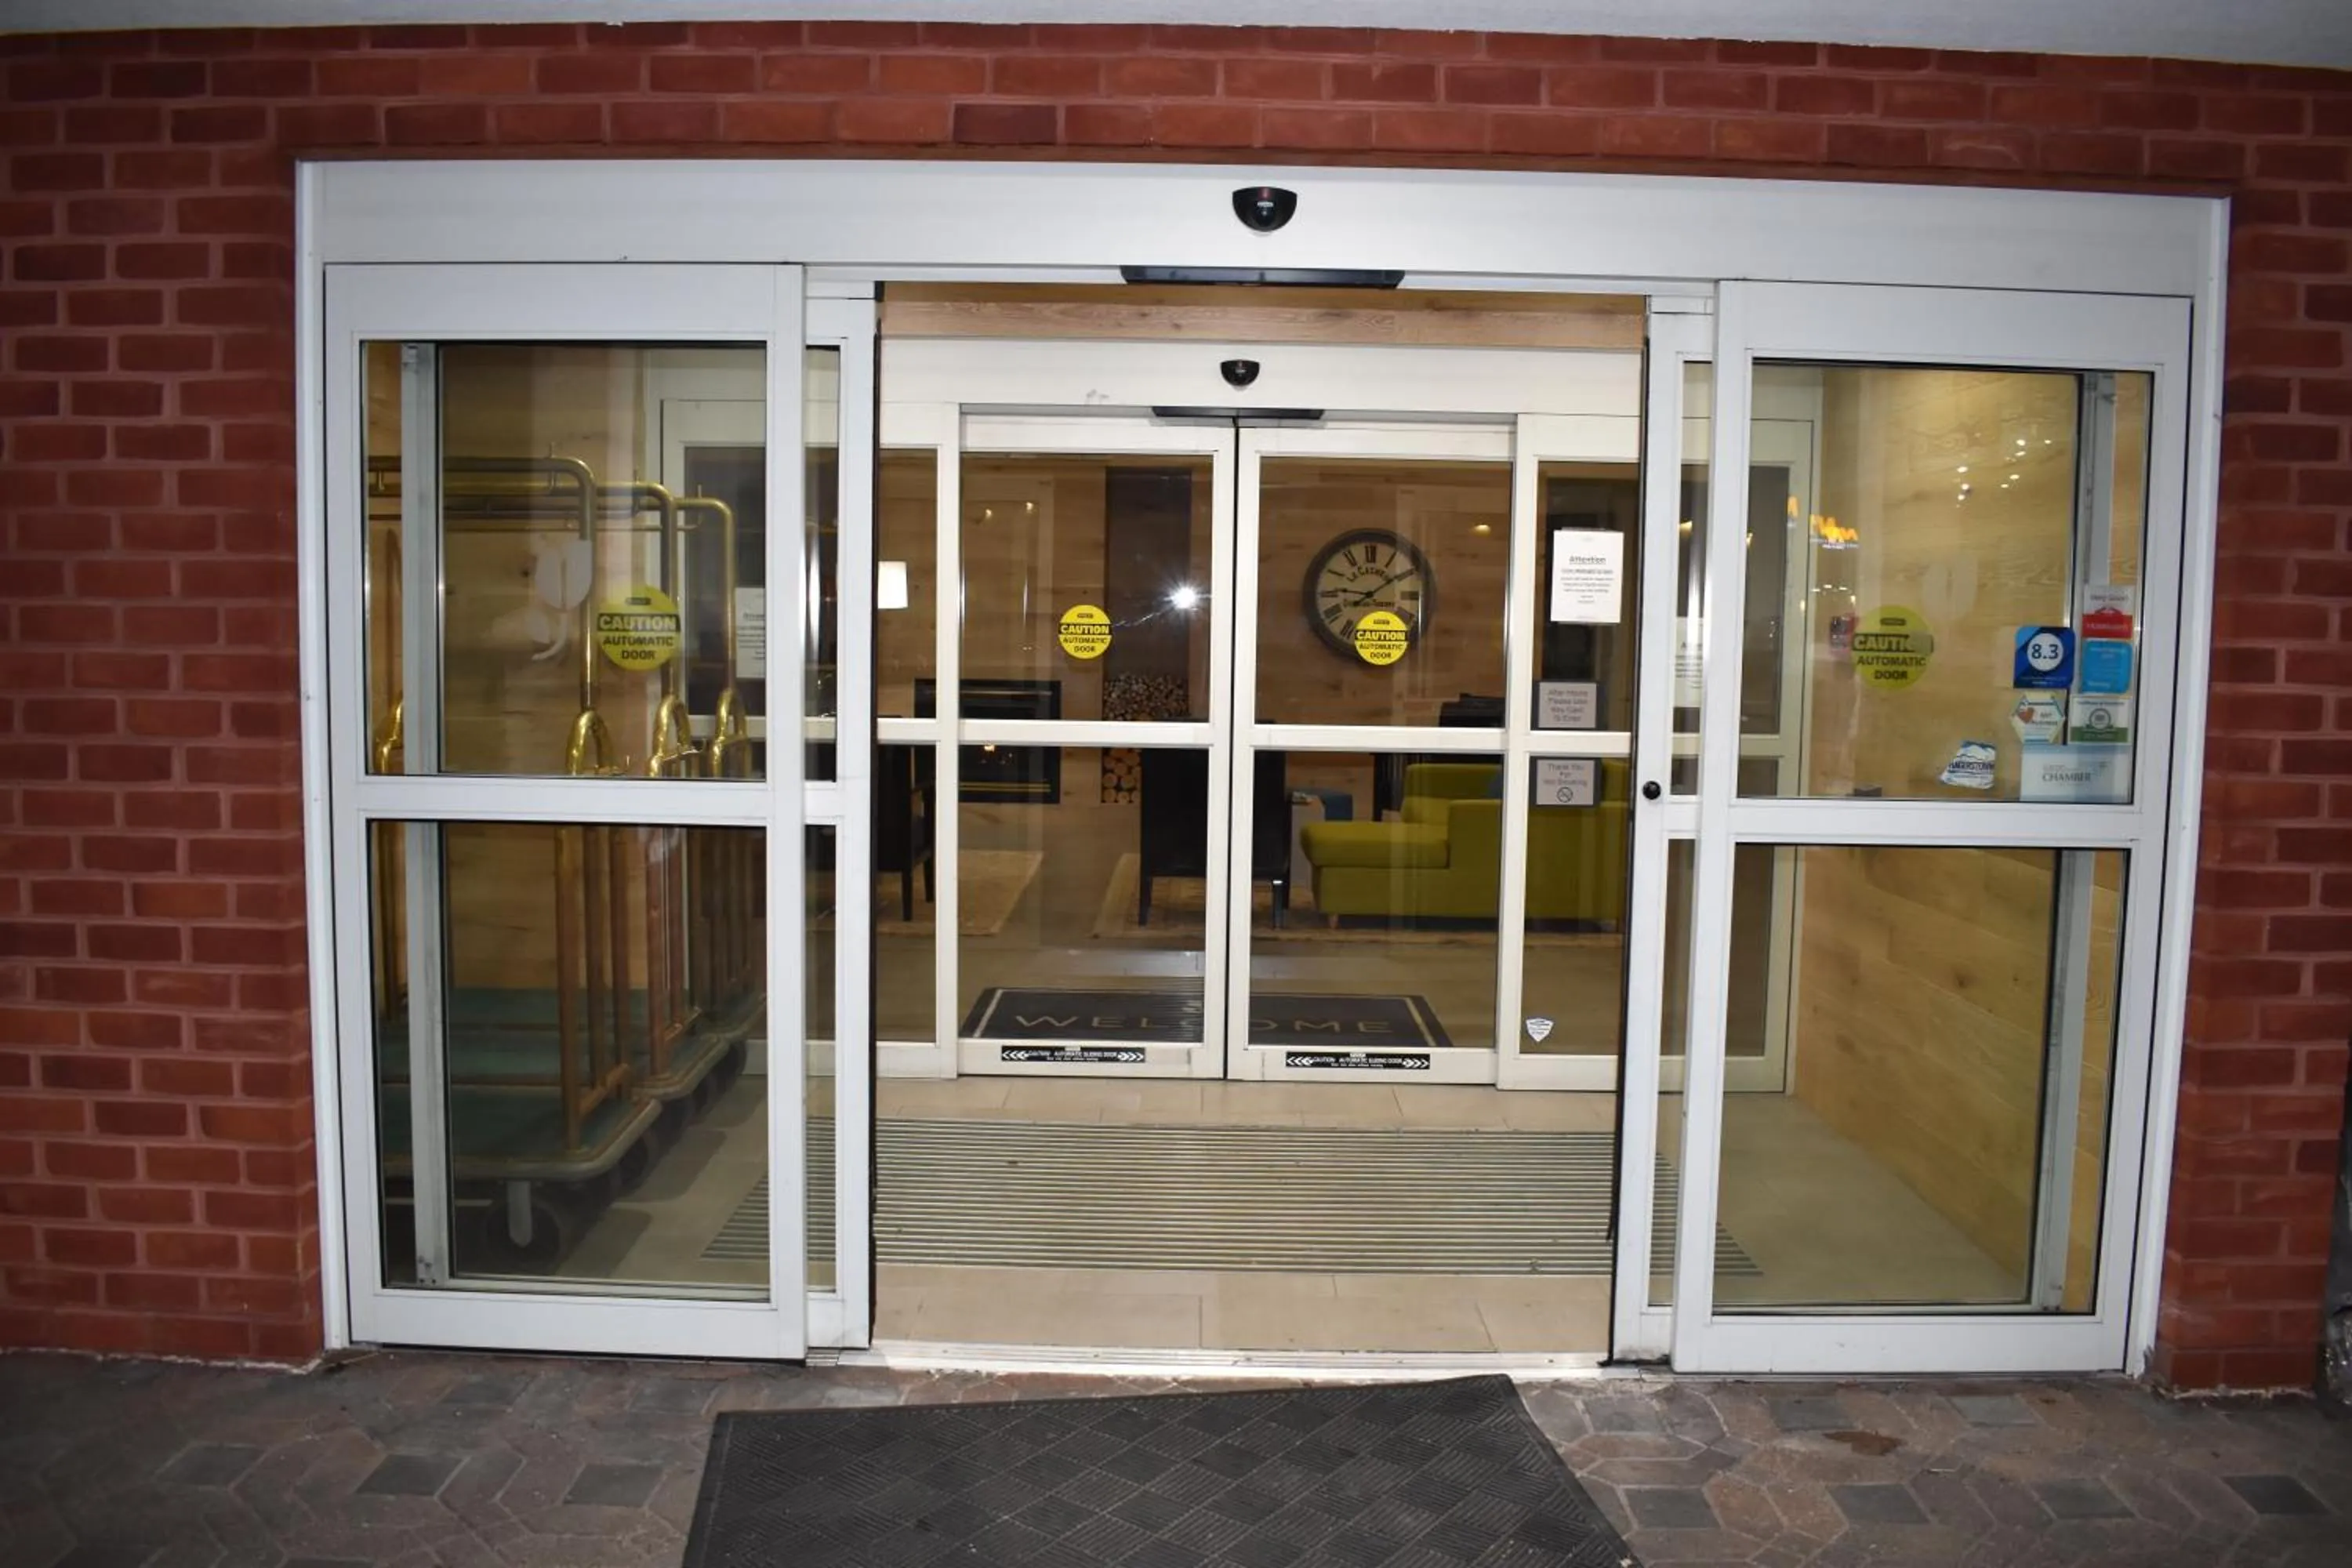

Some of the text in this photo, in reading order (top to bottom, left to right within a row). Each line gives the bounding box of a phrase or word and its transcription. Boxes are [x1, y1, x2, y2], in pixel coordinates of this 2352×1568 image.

[1569, 555, 1606, 564] Attention
[599, 615, 677, 630] CAUTION
[1061, 625, 1109, 634] CAUTION
[1357, 631, 1406, 641] CAUTION
[602, 636, 674, 647] AUTOMATIC
[1854, 635, 1918, 651] CAUTI
[621, 650, 655, 660] DOOR
[2031, 644, 2060, 660] 8.3
[1857, 656, 1926, 666] AUTOMATIC
[1874, 670, 1908, 680] DOOR
[2042, 772, 2092, 782] CHAMBER
